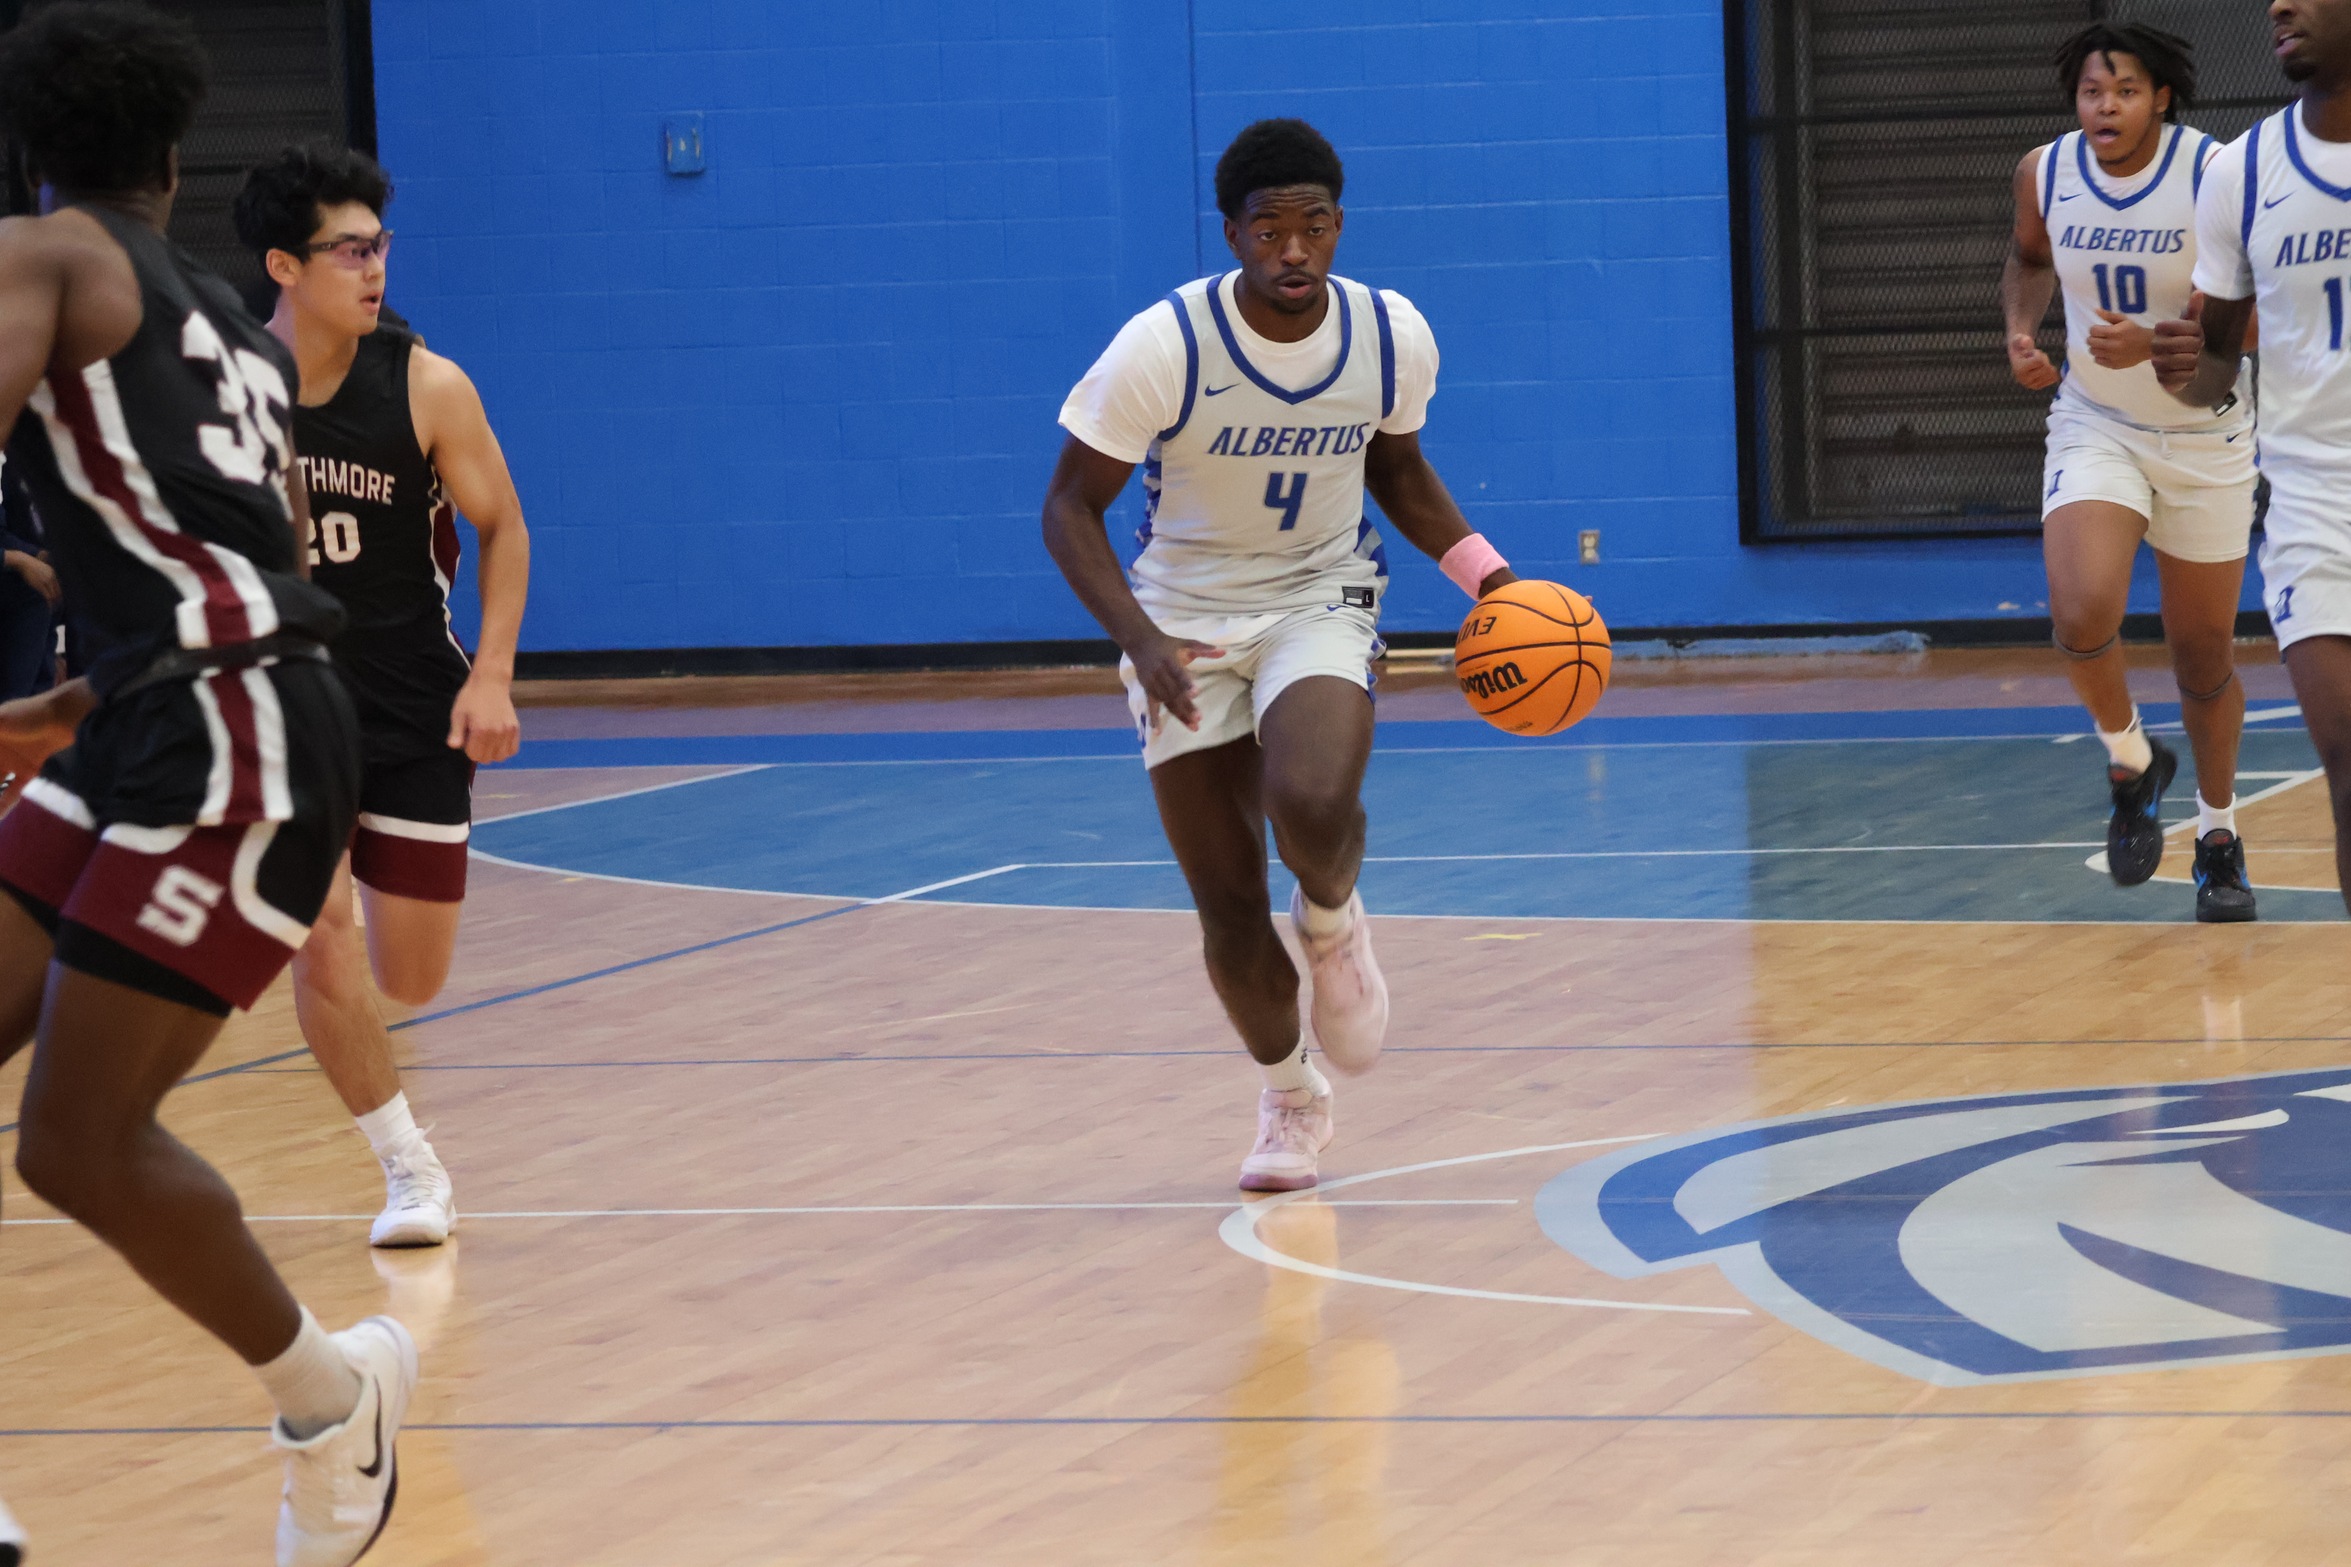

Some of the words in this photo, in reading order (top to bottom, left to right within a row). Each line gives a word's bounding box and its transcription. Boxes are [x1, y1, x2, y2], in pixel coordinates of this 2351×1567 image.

[2059, 225, 2186, 254] ALBERTUS
[2092, 263, 2148, 314] 10
[2323, 276, 2351, 352] 1
[1205, 422, 1370, 457] ALBERTUS
[1263, 471, 1308, 532] 4
[136, 864, 225, 947] S
